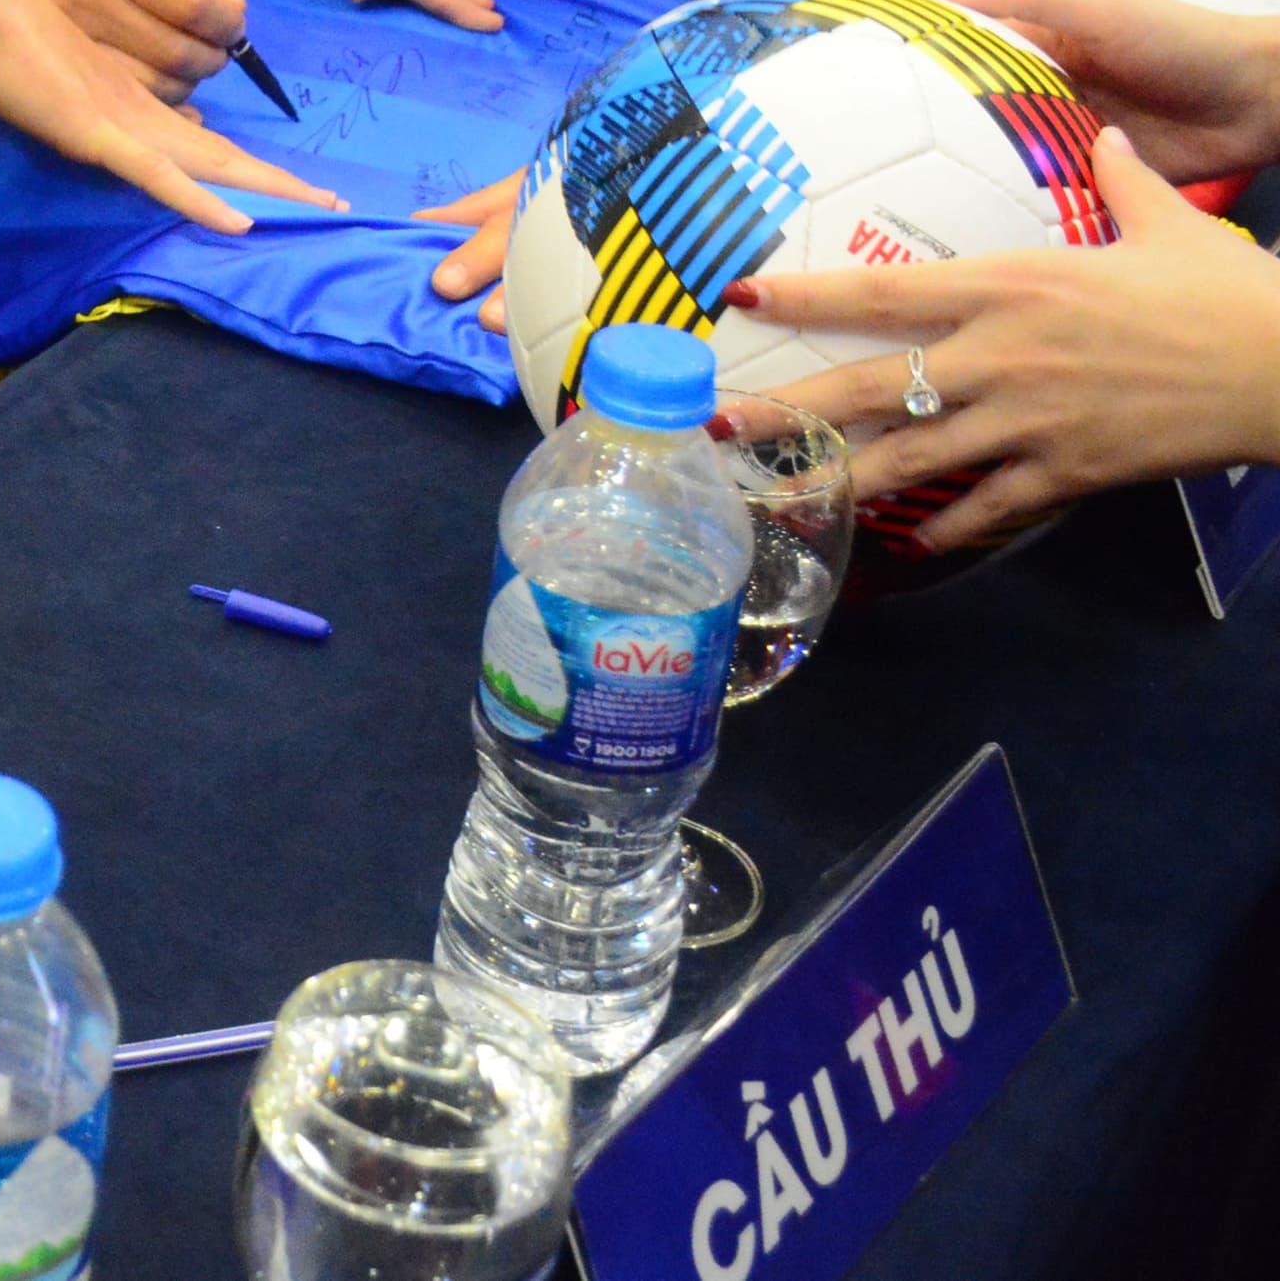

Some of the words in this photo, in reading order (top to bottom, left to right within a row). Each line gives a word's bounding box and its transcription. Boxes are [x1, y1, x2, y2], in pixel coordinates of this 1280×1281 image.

[593, 640, 696, 675] laVie
[595, 742, 637, 758] 1900
[691, 1065, 849, 1281] CẦU
[845, 905, 977, 1123] THỦ
